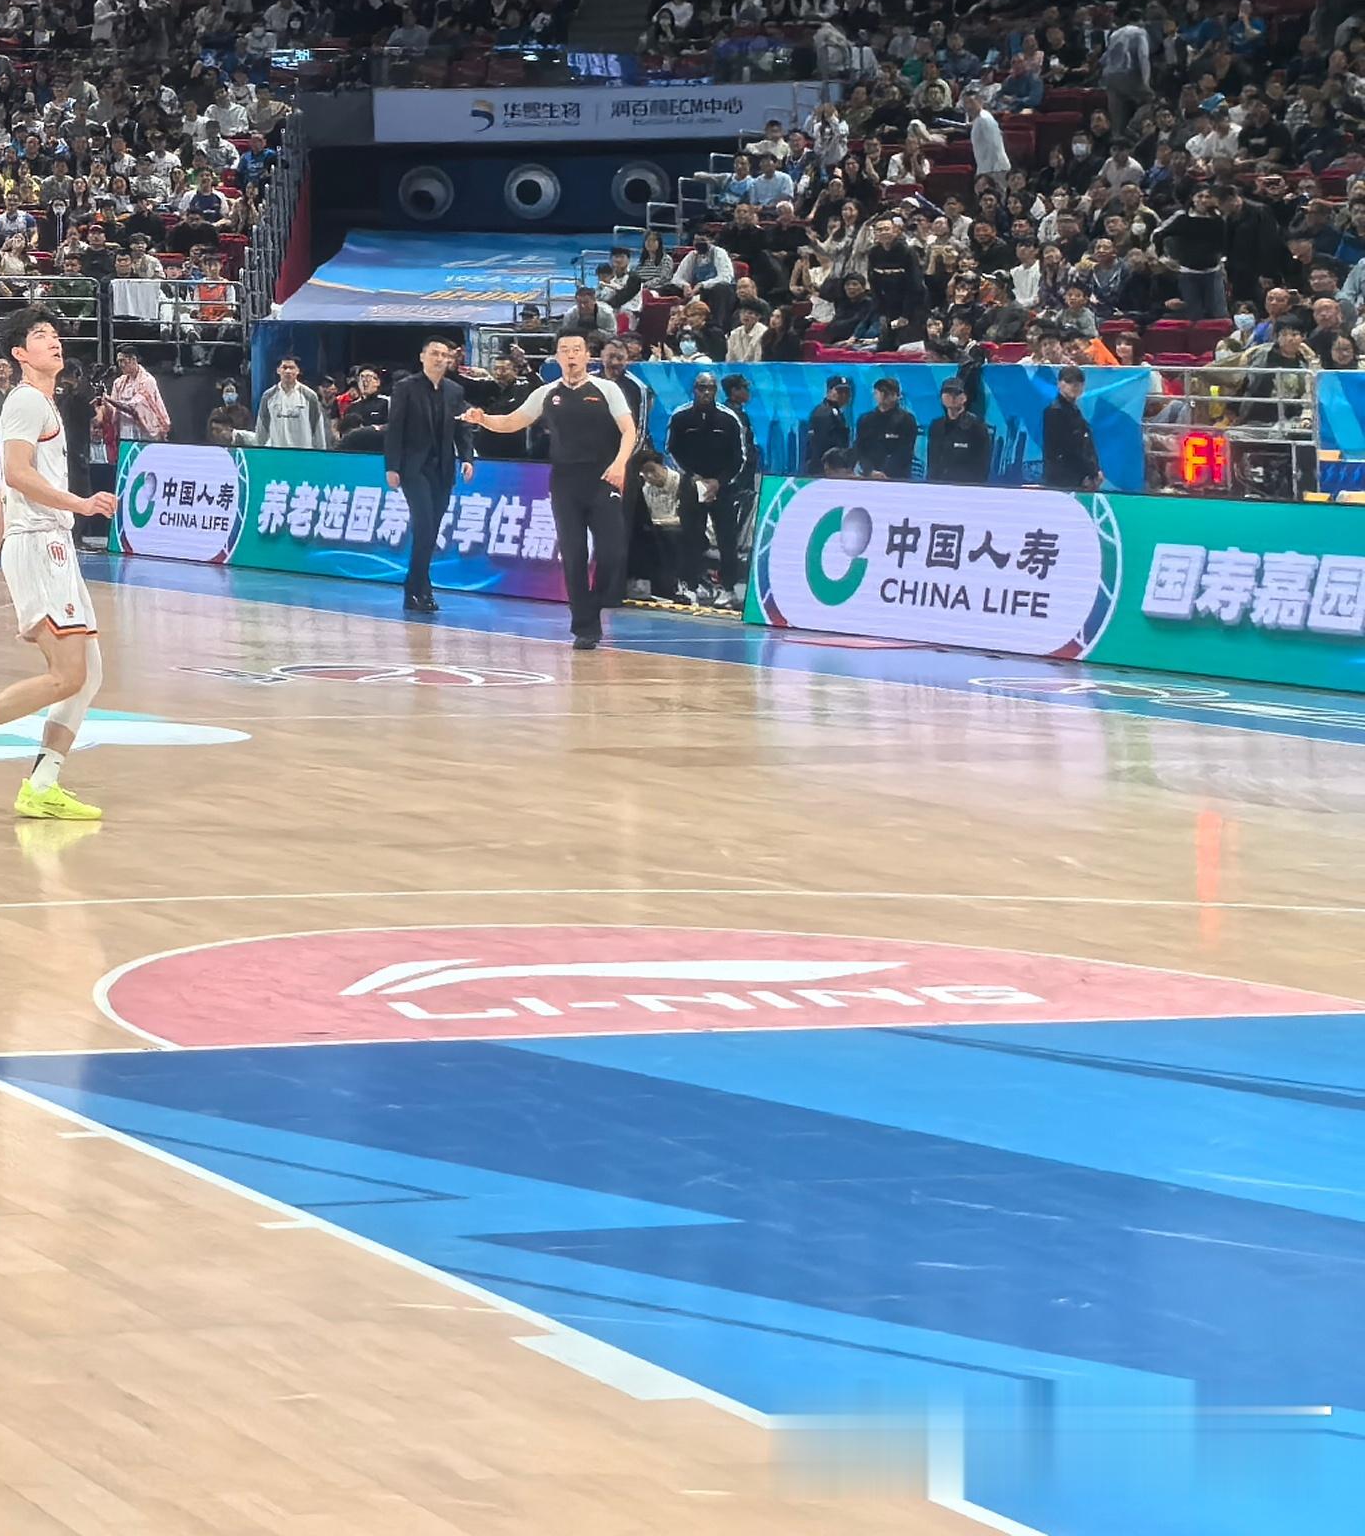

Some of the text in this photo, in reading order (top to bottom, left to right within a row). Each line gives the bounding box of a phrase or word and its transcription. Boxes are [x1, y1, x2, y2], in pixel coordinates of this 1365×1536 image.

[162, 476, 235, 512] 中国人寿
[158, 511, 230, 533] CHINA LIFE
[885, 515, 1061, 581] 中国人寿
[879, 577, 1051, 620] CHINA LIFE
[1141, 542, 1365, 638] 国寿嘉园
[387, 984, 1047, 1022] LI-NING
